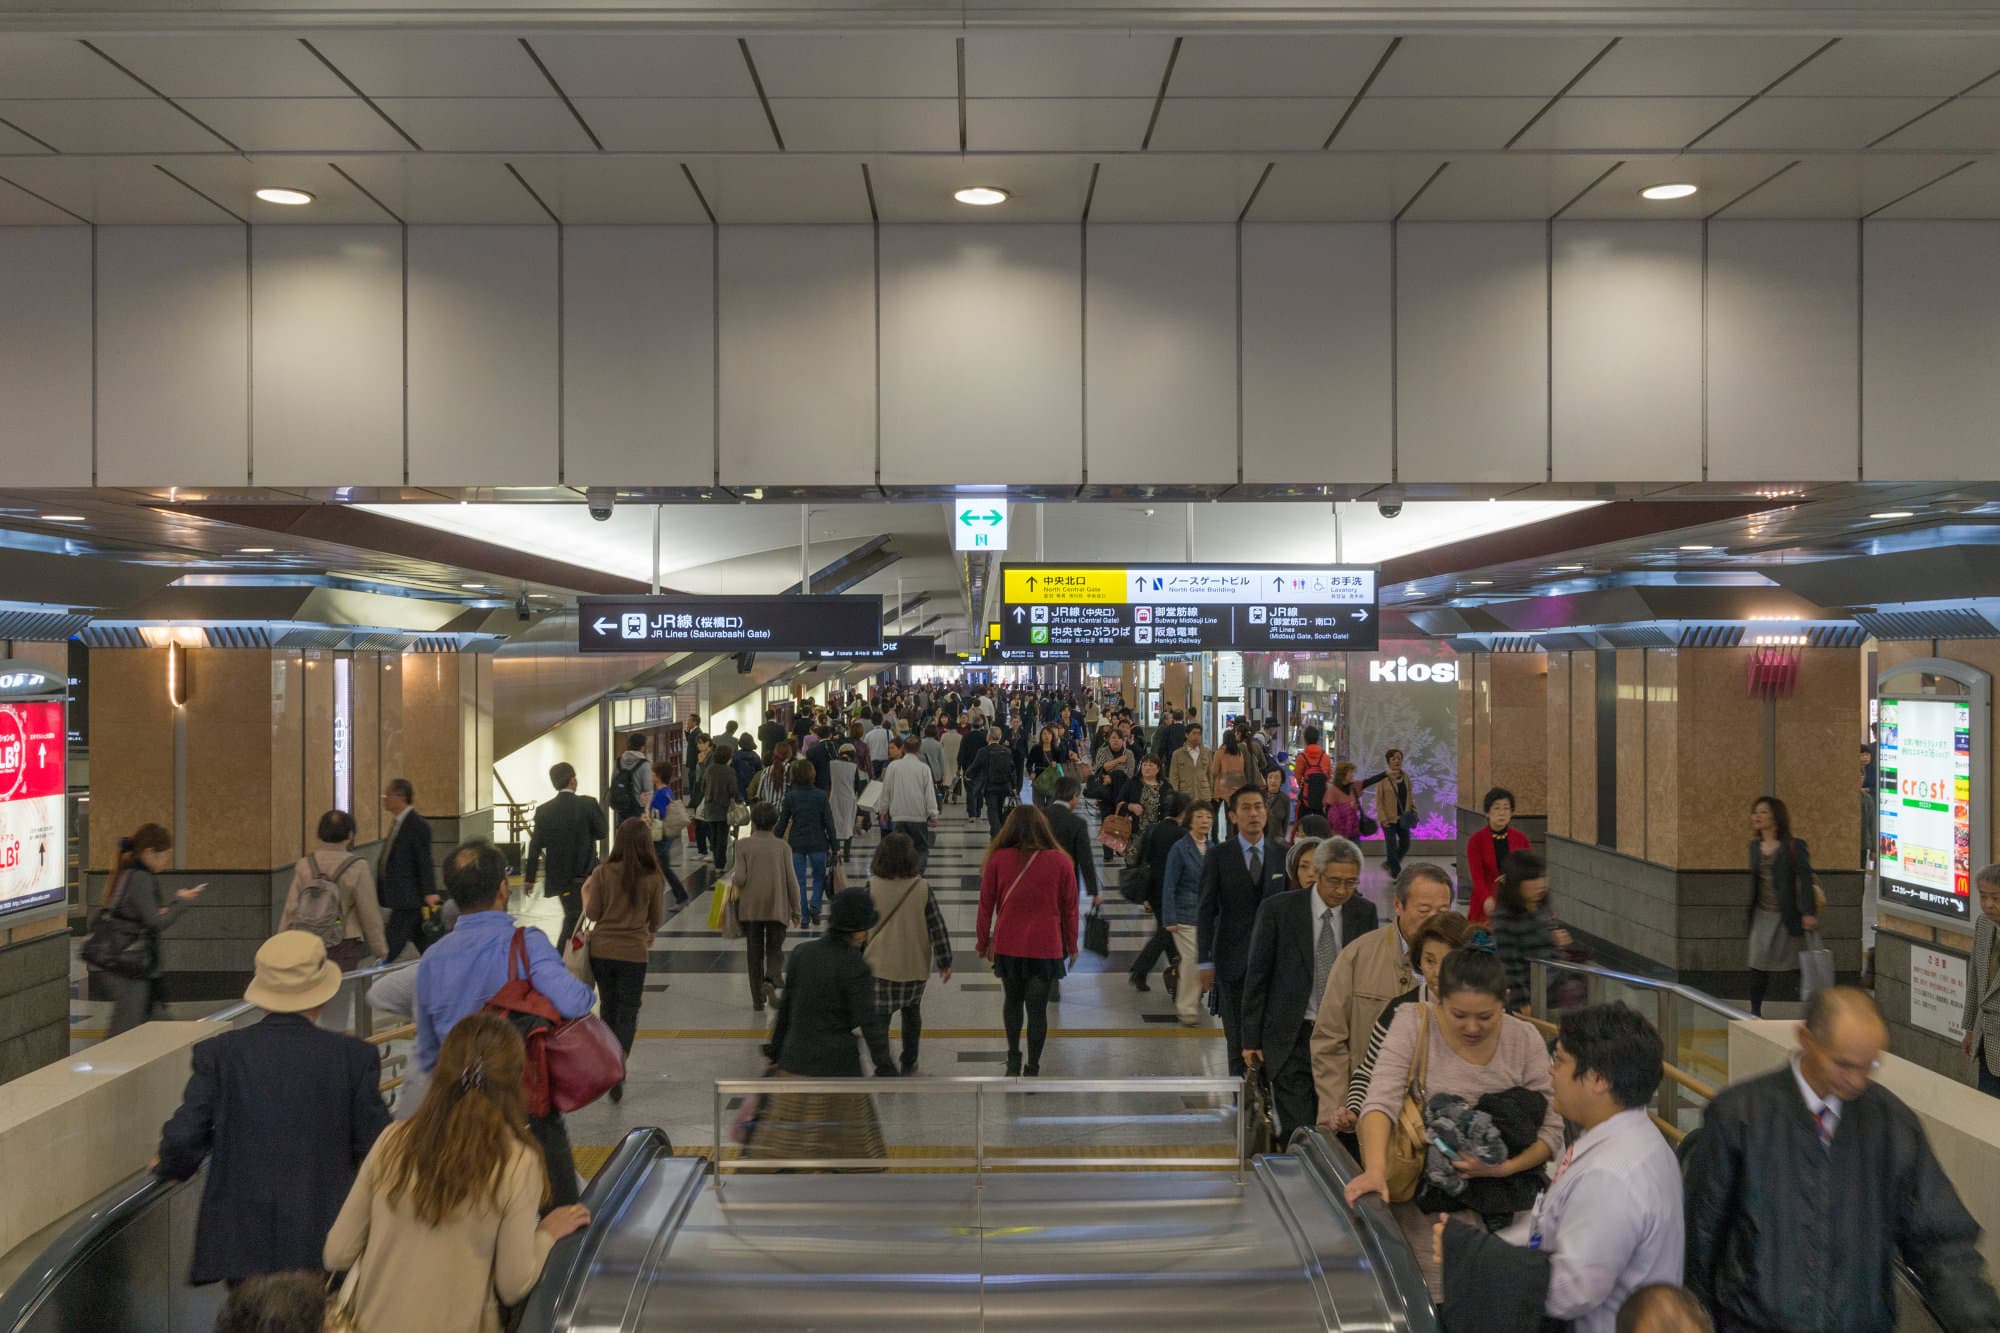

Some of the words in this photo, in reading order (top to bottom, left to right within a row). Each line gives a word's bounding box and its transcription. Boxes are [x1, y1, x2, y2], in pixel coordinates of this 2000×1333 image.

[1043, 576, 1086, 586] 中央北口
[1169, 576, 1250, 586] ノースゲートビル
[1331, 576, 1363, 586] お手洗
[1155, 607, 1198, 617] 御堂筋線
[1269, 607, 1298, 617] JR線
[650, 630, 663, 638] JR
[665, 630, 688, 638] Lines
[690, 630, 745, 639] (Sakurabashi
[747, 630, 771, 639] Gate)
[1051, 627, 1130, 637] 中央きっぷうりば
[1155, 627, 1198, 637] 阪急電車
[1370, 656, 1458, 683] Kios
